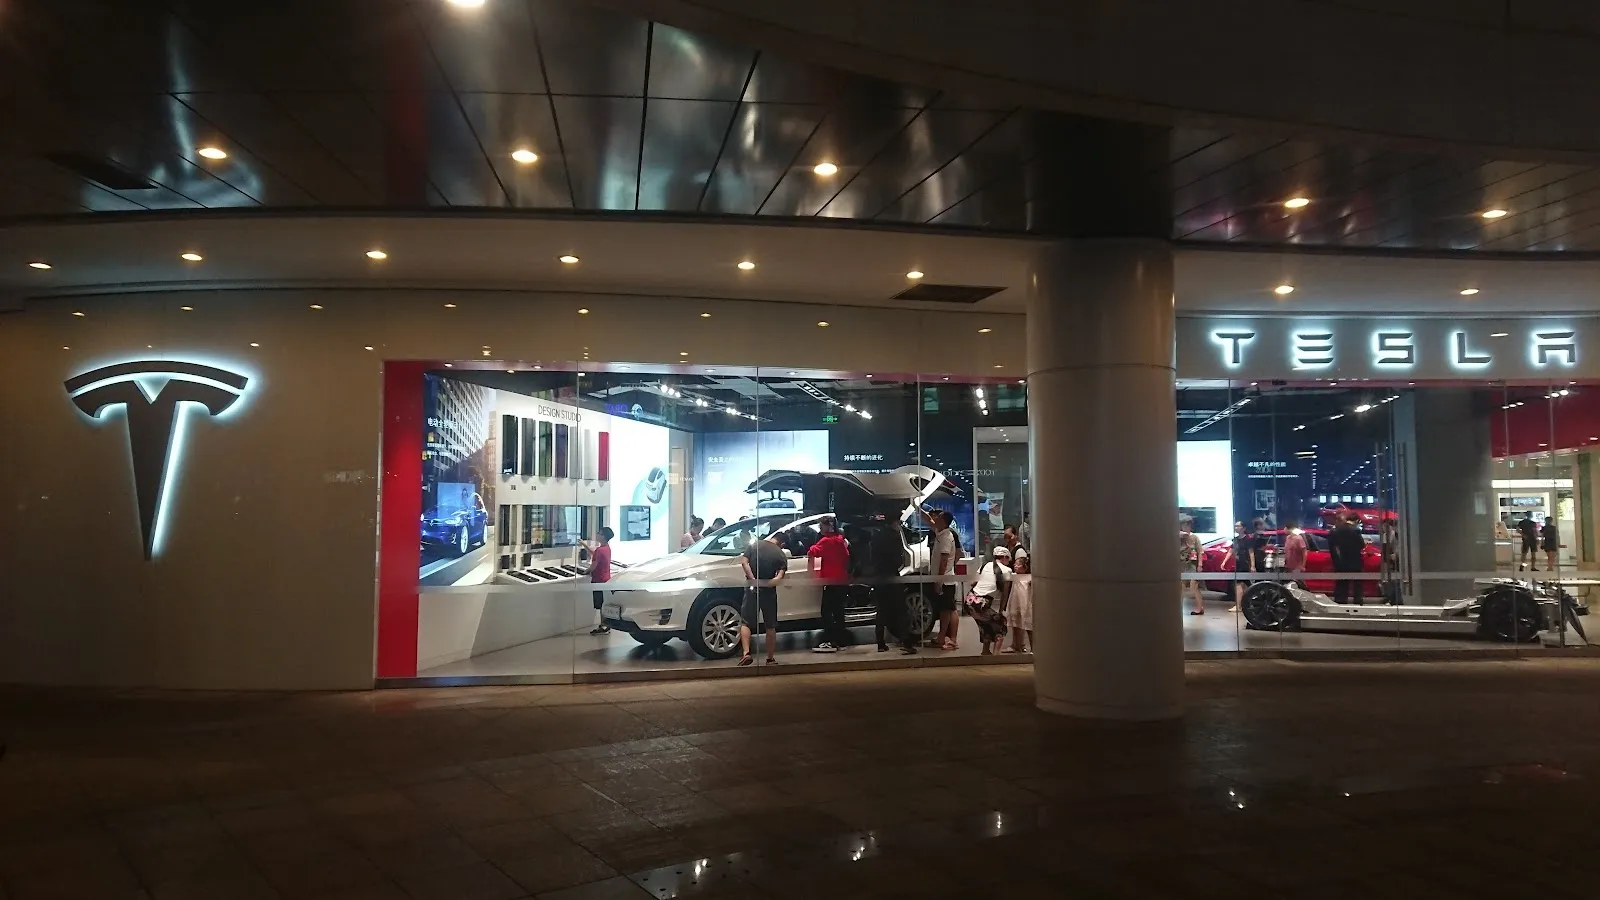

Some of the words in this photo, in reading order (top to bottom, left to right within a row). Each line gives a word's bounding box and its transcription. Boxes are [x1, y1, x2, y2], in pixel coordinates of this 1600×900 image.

[1213, 330, 1577, 366] TESLA
[538, 404, 560, 418] DESIGN
[561, 409, 582, 423] STUDIO
